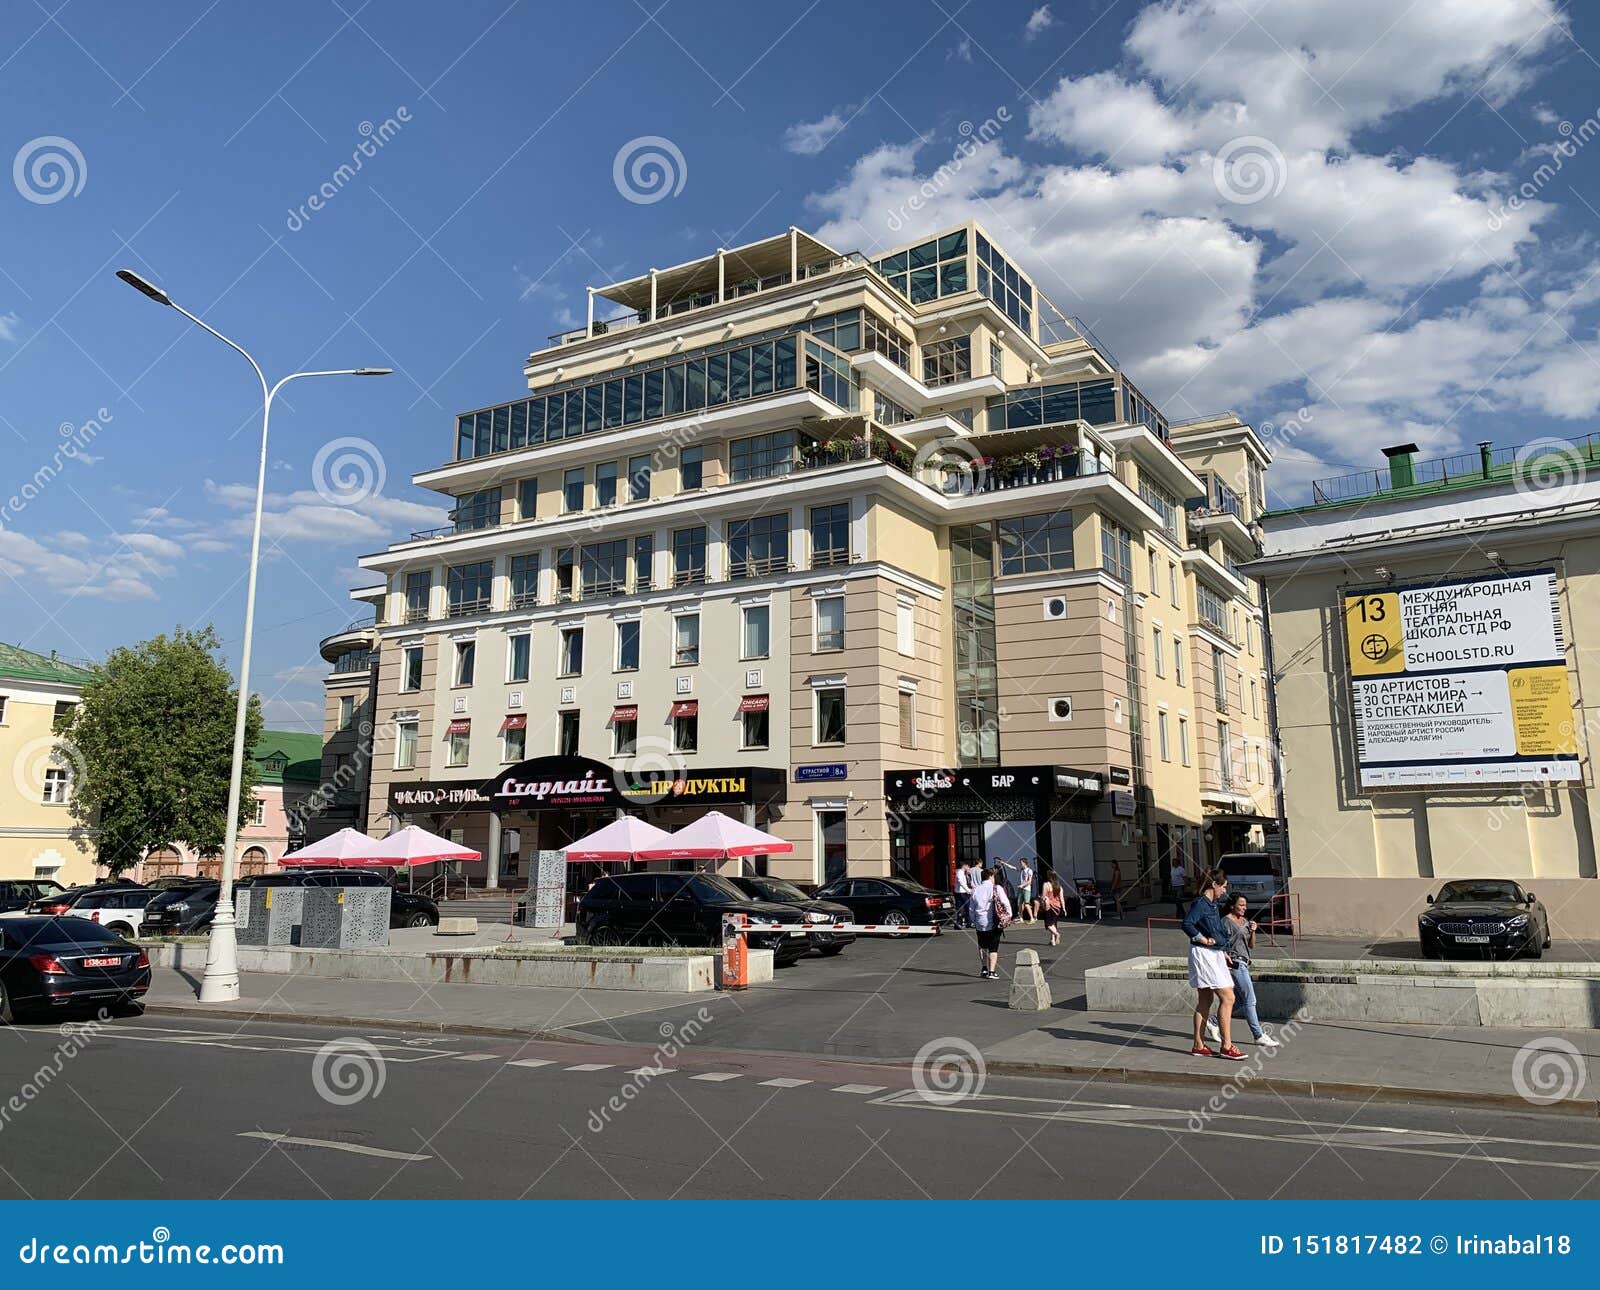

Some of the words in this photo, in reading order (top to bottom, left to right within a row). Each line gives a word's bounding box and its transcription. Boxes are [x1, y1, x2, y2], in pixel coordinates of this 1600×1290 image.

[1403, 580, 1531, 605] МЕЖДУНАРОДНАЯ
[1356, 598, 1386, 622] 13
[1404, 601, 1457, 617] ЛЕТНЯЯ
[1404, 608, 1502, 628] ТЕАТРАЛЬНАЯ
[1406, 626, 1456, 640] ШКОЛА
[1459, 623, 1488, 636] СТД
[1490, 620, 1512, 633] РФ
[1408, 645, 1514, 664] SCHOOLSTD.RU
[1363, 683, 1377, 694] 90
[1380, 678, 1450, 693] АРТИСТОВ
[1364, 695, 1378, 706] 30
[1382, 693, 1424, 705] СТРАН
[1428, 689, 1467, 703] МИРА
[1365, 707, 1373, 718] 5
[1375, 700, 1464, 718] СПЕКТАКЛЕЙ
[1367, 720, 1433, 731] ХУДОЖЕСТВЕННЫЙ
[1434, 718, 1493, 728] РУКОВОДИТЕЛЬ:
[1367, 728, 1406, 737] НАРОДНЫЙ
[1407, 727, 1433, 736] АРТИСТ
[1435, 726, 1465, 734] РОССИИ
[991, 775, 1015, 788] БАР
